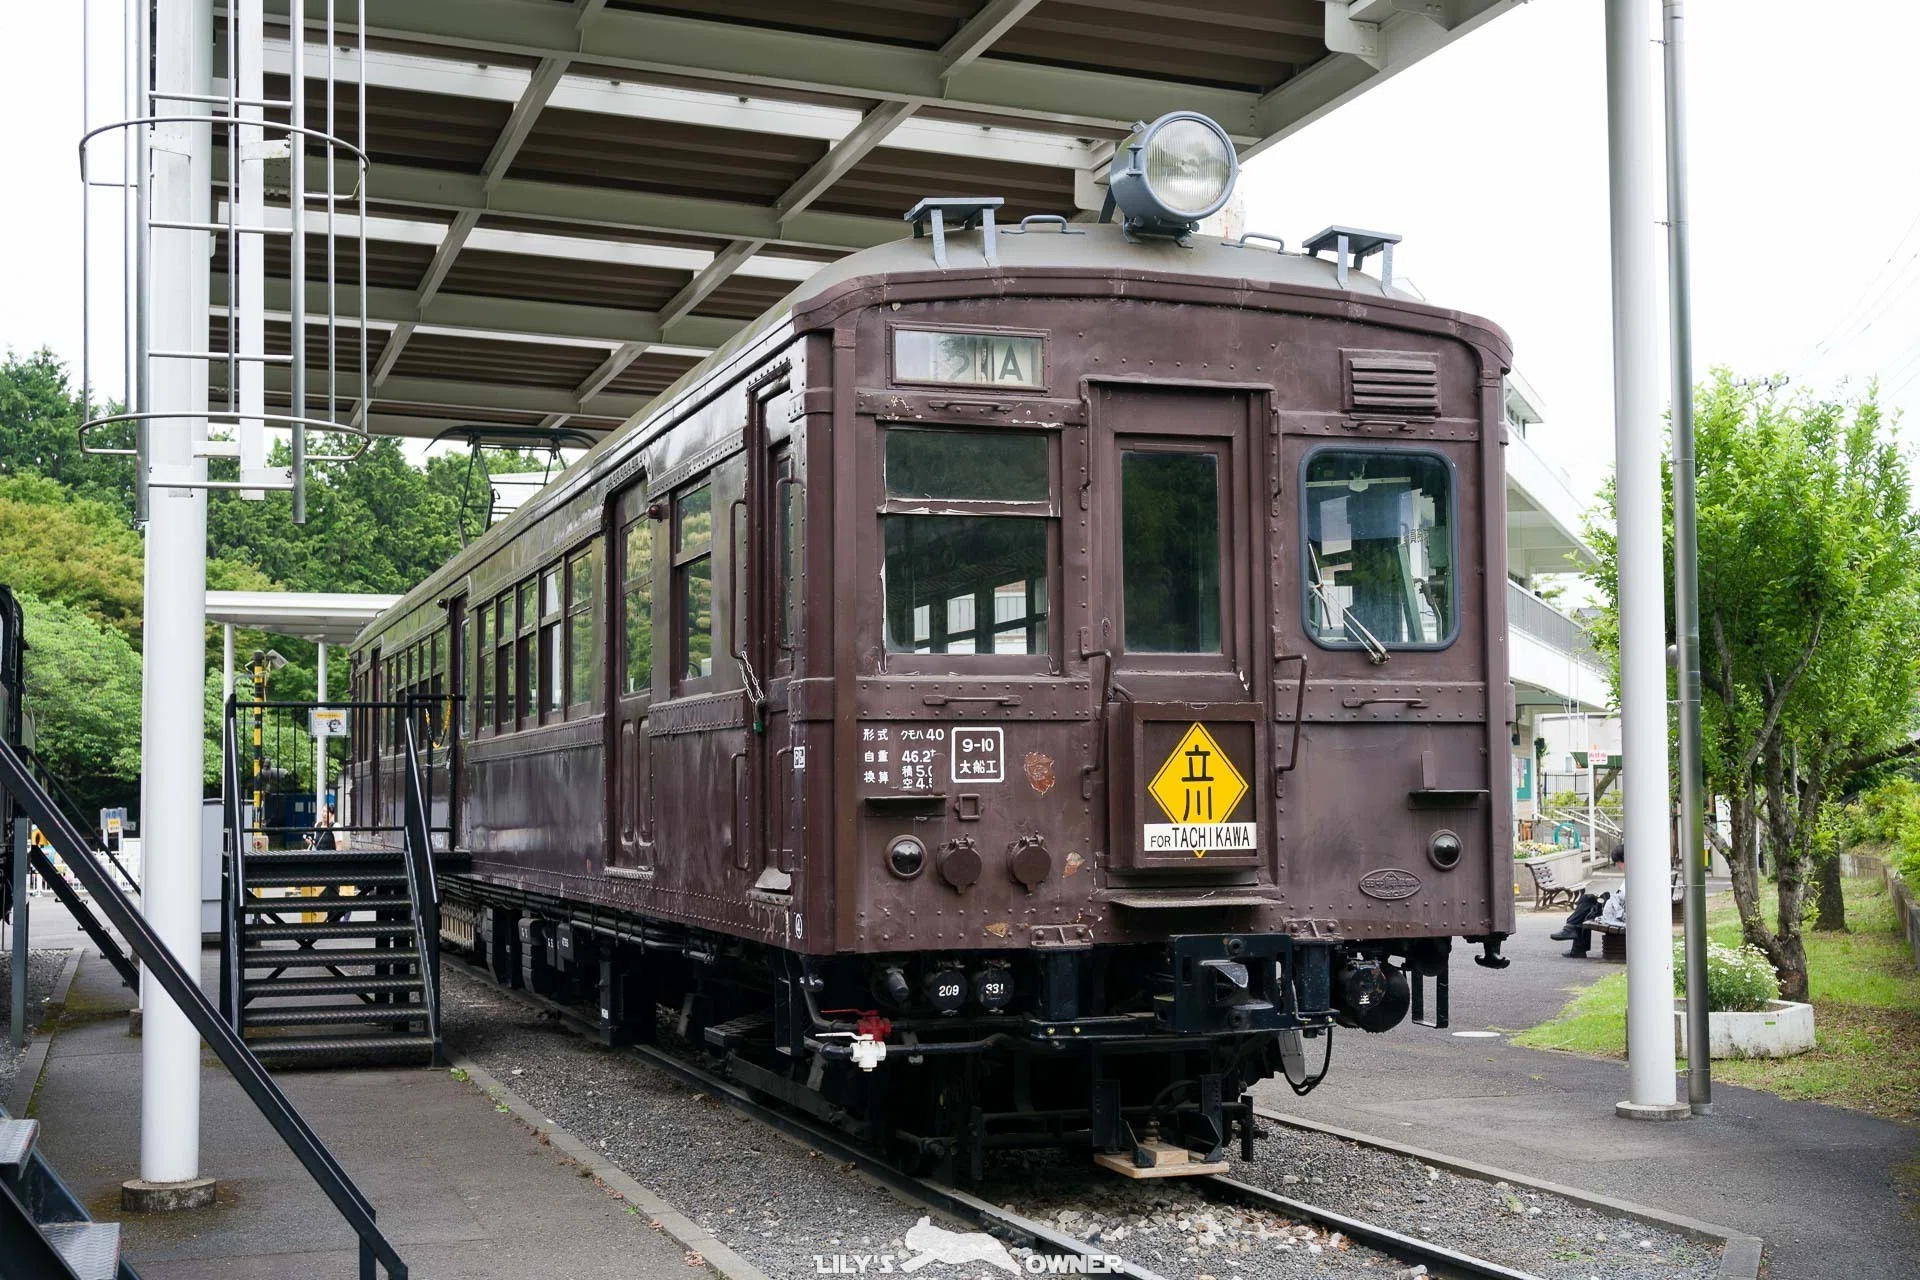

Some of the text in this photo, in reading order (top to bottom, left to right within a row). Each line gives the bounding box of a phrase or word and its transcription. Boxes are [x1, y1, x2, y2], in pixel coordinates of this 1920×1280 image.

[863, 728, 889, 741] 形式
[962, 738, 995, 752] 9-10
[864, 750, 889, 763] 自重
[1181, 744, 1214, 822] 立川
[1150, 826, 1250, 848] FOR TACHIKAWA
[938, 984, 960, 997] 209
